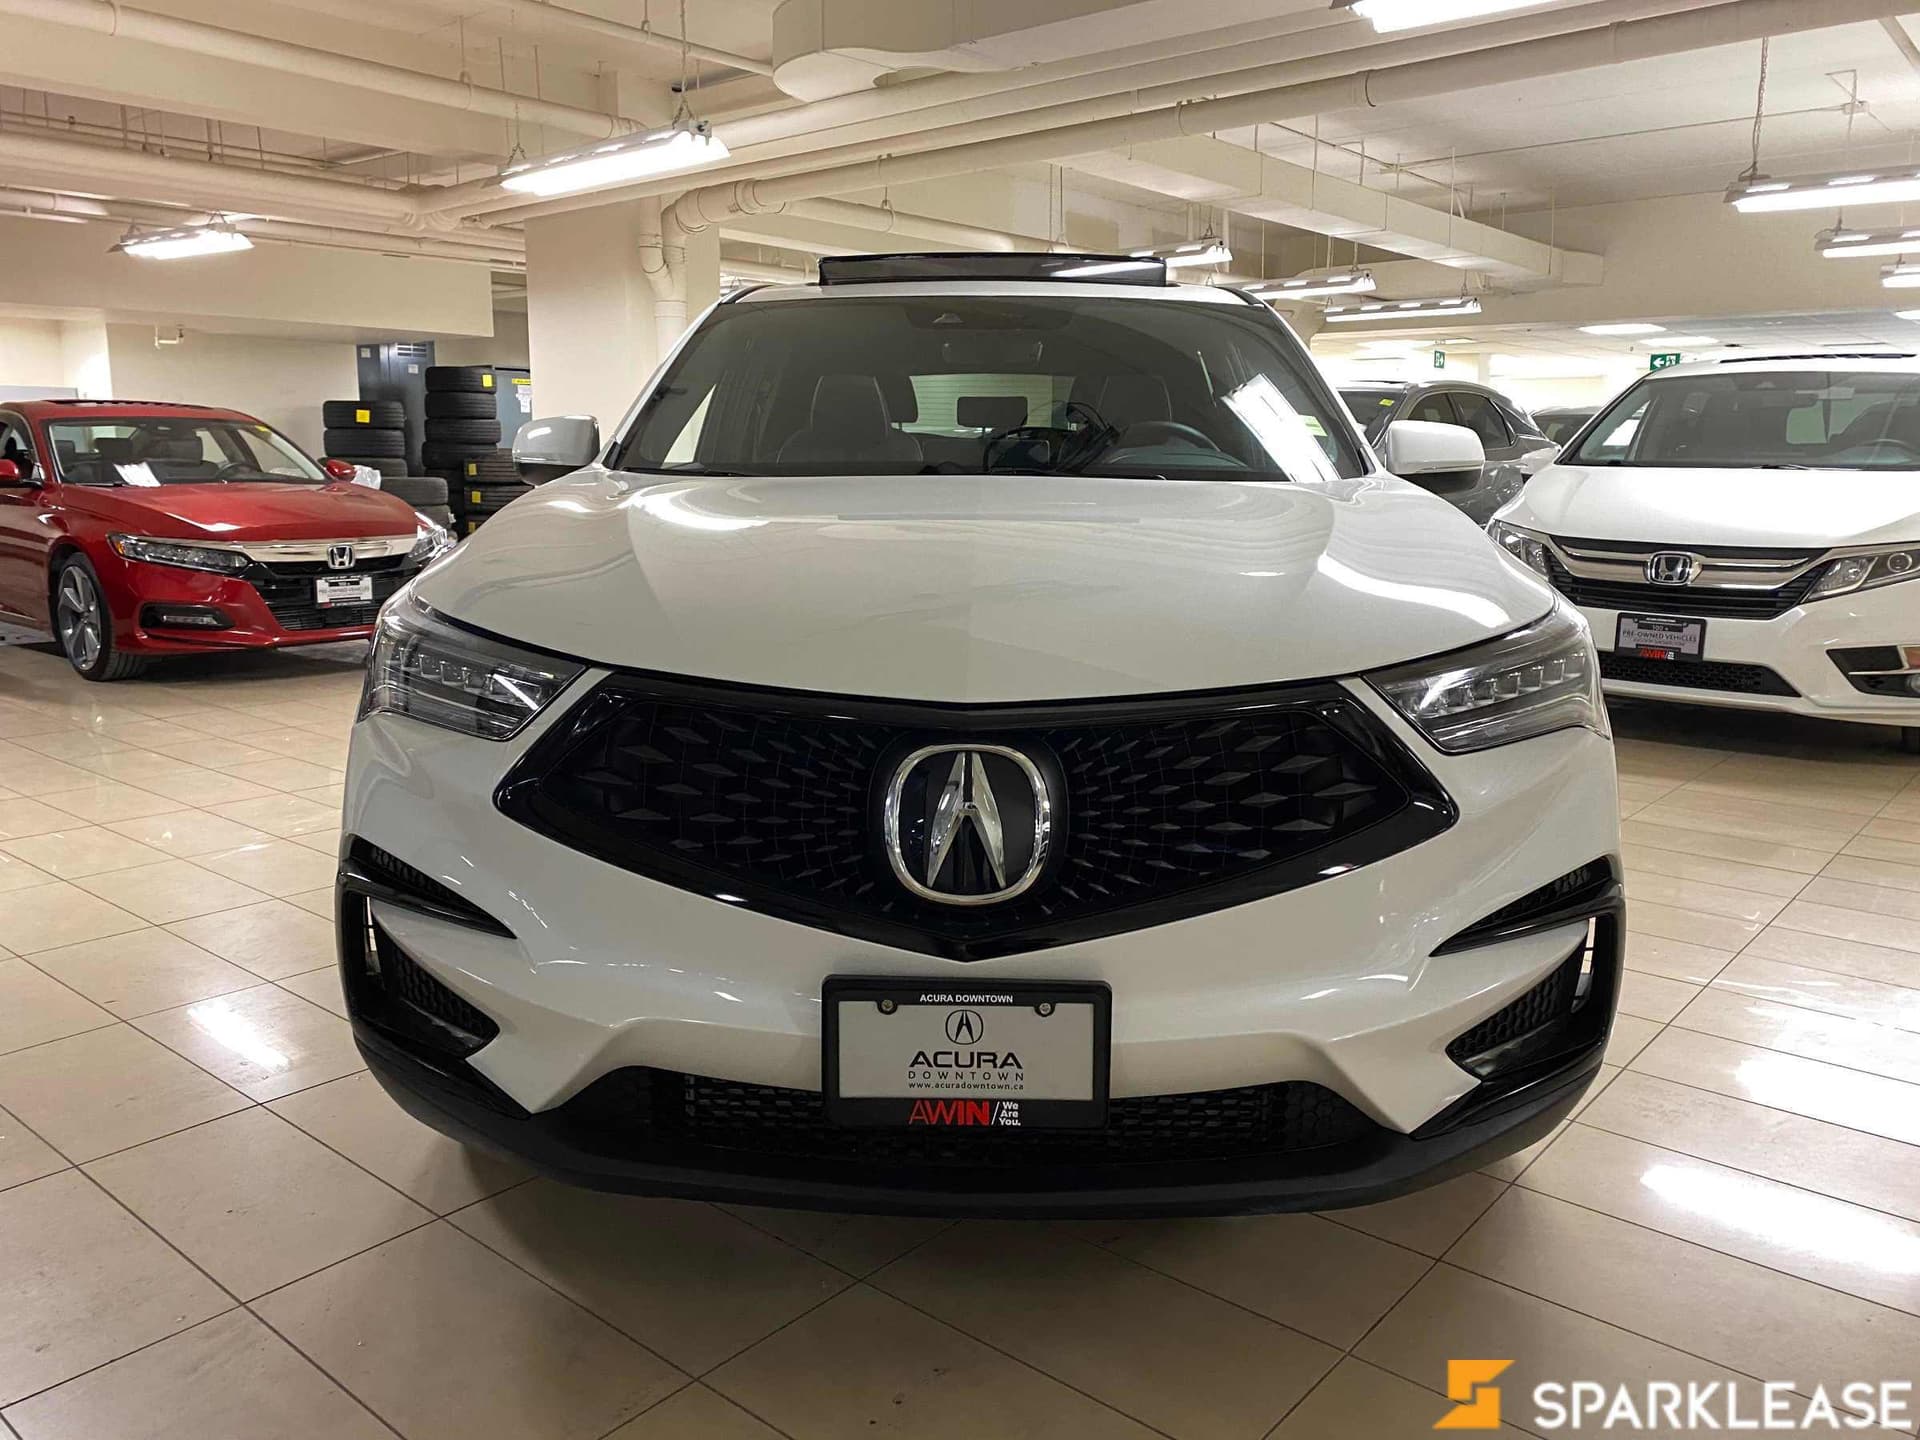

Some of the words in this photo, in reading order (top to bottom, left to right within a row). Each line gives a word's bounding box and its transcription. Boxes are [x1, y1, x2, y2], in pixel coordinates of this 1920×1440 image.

[1622, 630, 1664, 640] PRE-OWNED
[919, 994, 954, 1002] ACURA
[955, 994, 1014, 1003] DOWNTOWN
[909, 1050, 1023, 1069] ACURA
[908, 1070, 1024, 1081] DOWNTOWN
[908, 1081, 1024, 1090] www.acuradowntown.ca
[1002, 1101, 1019, 1110] We
[908, 1099, 990, 1126] AWIN
[1000, 1110, 1019, 1118] Are
[999, 1117, 1022, 1126] You.
